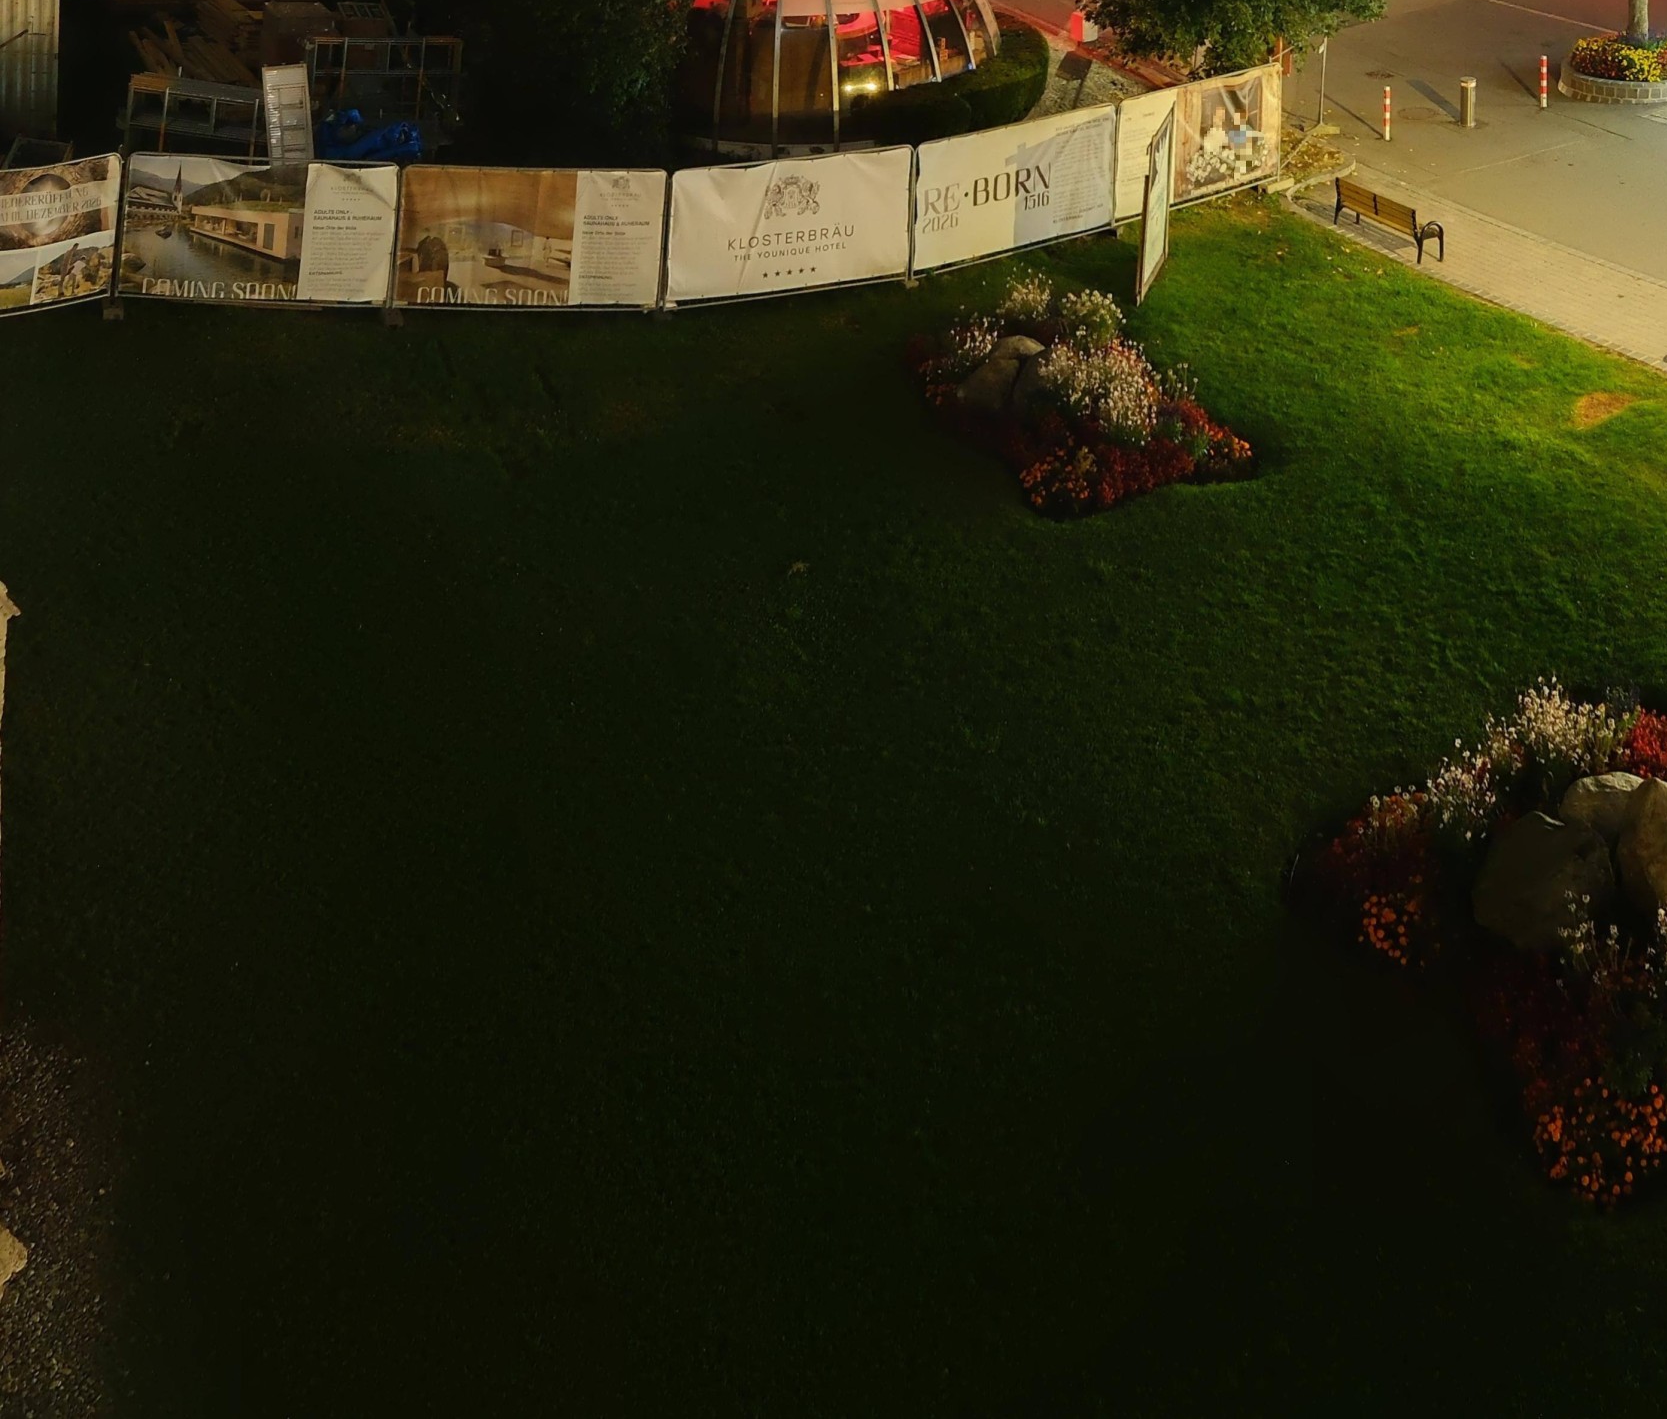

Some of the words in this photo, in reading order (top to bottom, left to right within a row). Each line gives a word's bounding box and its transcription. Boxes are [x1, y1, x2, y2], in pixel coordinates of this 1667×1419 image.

[1023, 189, 1050, 212] 1516
[922, 211, 959, 235] 2026
[727, 223, 855, 252] KLOSTERBRÄU
[756, 246, 811, 261] YOUNIQUE
[815, 241, 847, 254] HOTEL
